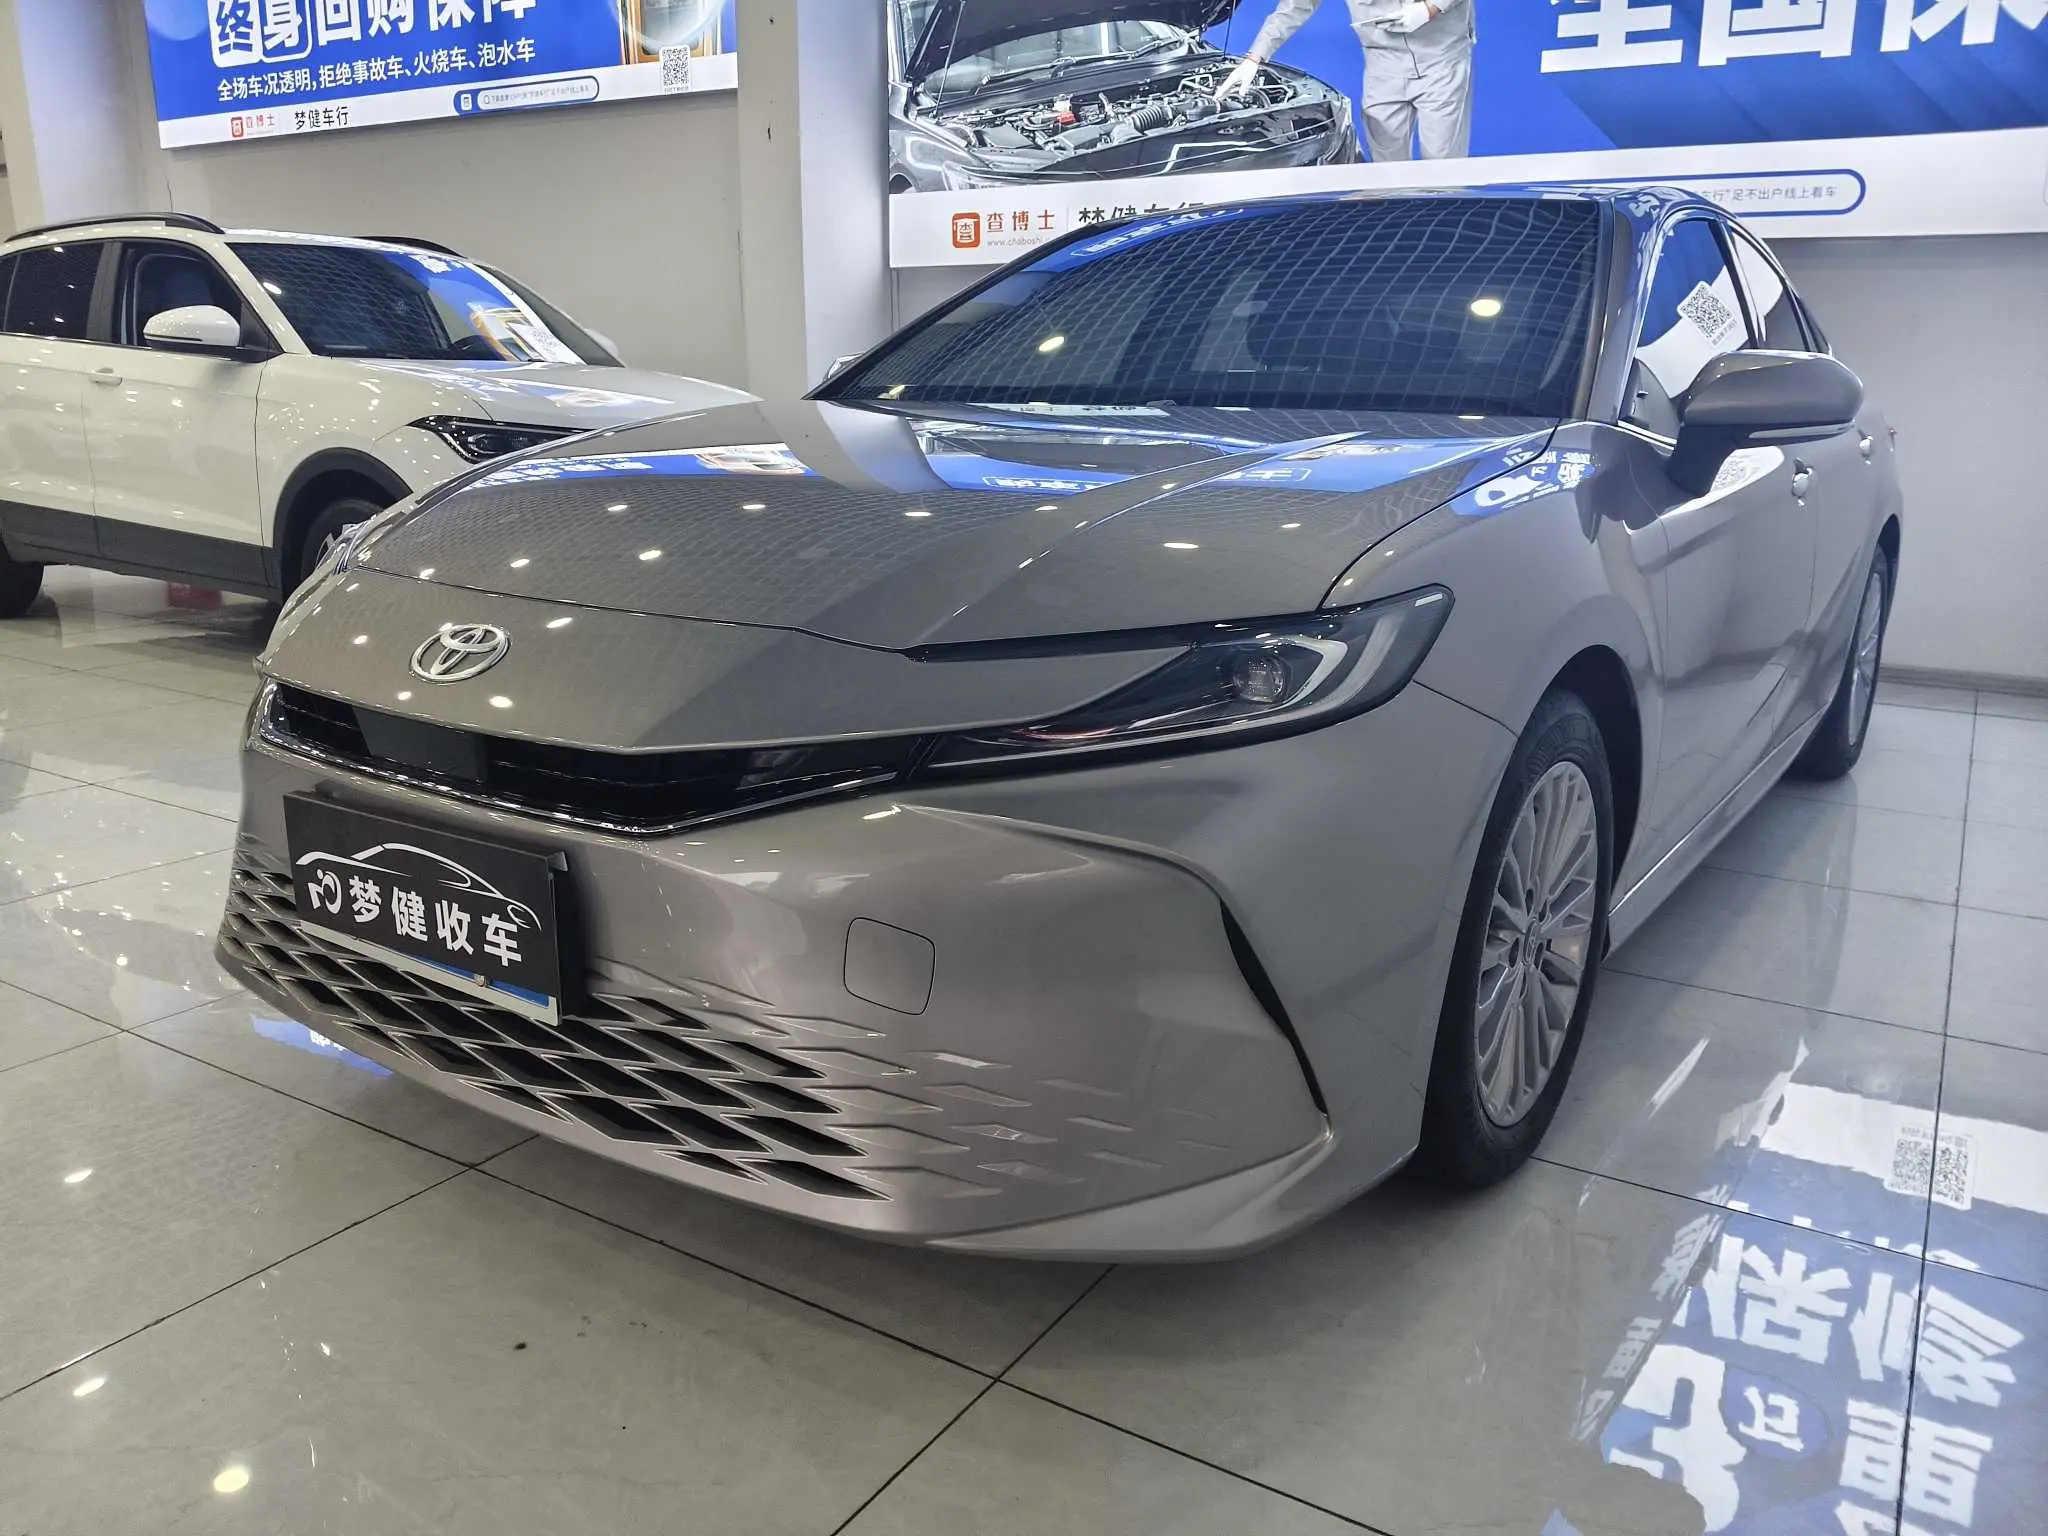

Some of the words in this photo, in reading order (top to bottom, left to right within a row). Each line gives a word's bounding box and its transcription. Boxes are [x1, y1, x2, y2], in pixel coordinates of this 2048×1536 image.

[294, 105, 349, 131] 梦健车行
[986, 209, 1056, 233] 查博士
[349, 873, 523, 968] 梦健收车
